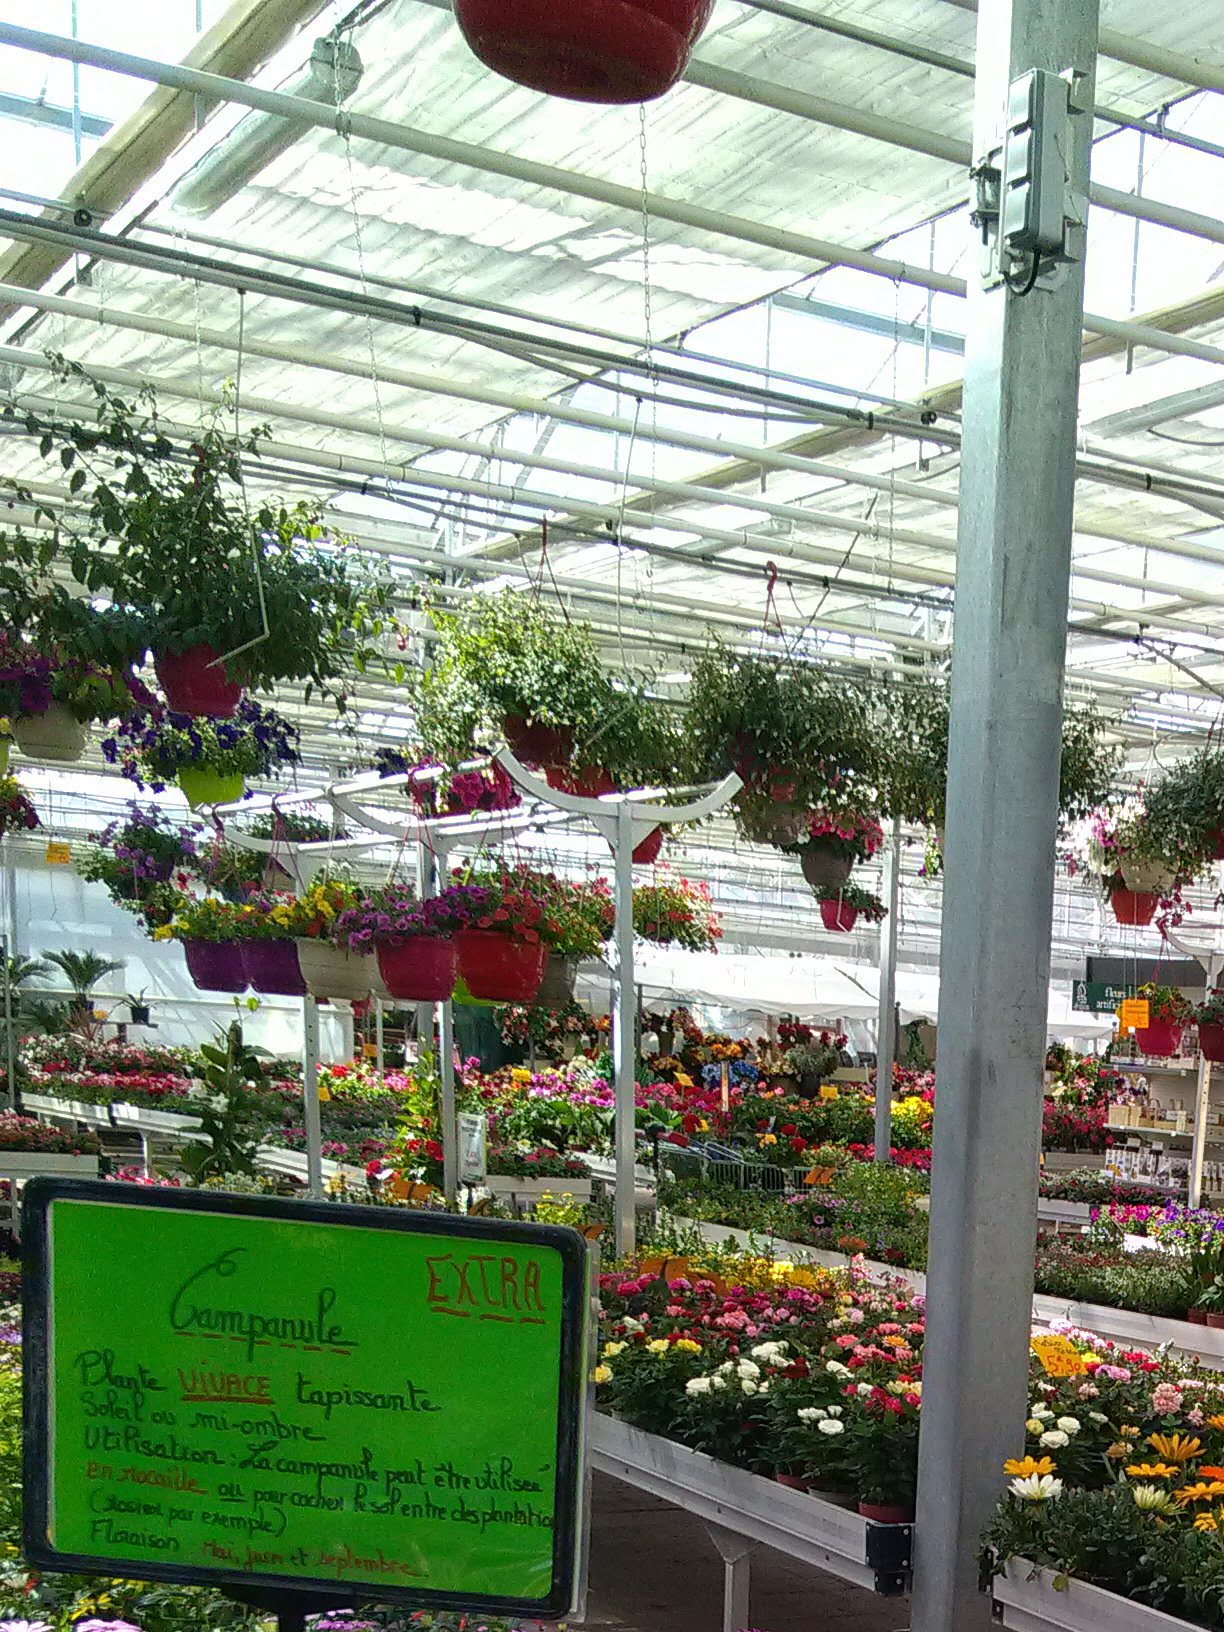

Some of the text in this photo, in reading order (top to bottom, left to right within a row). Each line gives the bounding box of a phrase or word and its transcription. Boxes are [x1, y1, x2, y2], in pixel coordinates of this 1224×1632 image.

[171, 1247, 546, 1362] Campanule EXTRA
[74, 1348, 168, 1392] Plante
[297, 1369, 443, 1422] tapissante
[151, 1411, 176, 1426] ou
[290, 1547, 309, 1567] et
